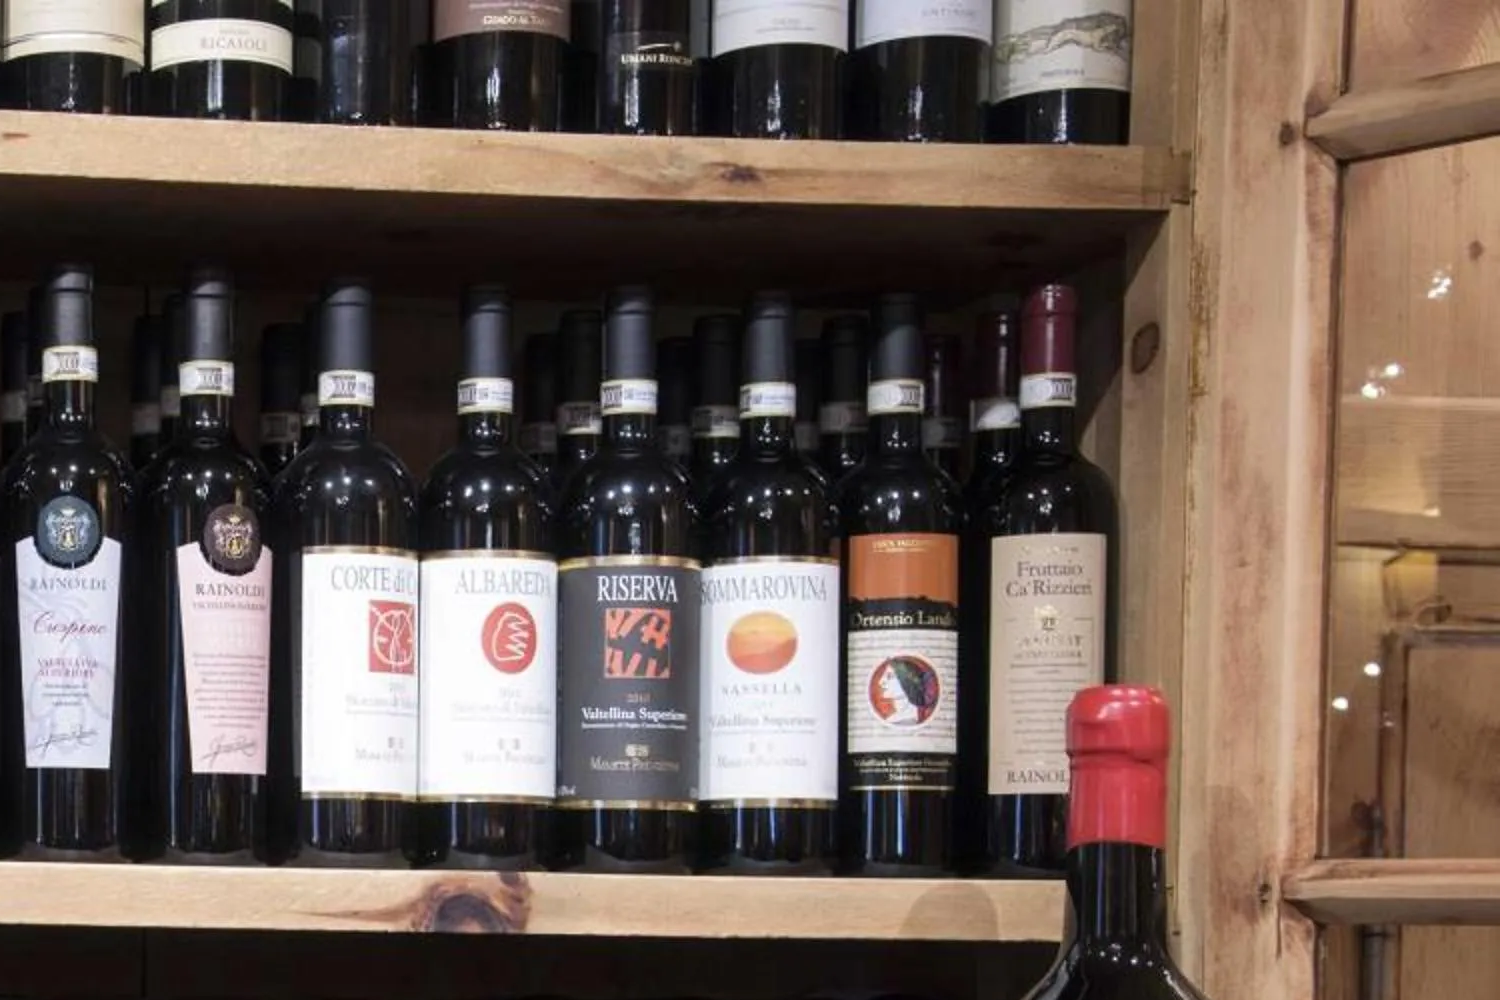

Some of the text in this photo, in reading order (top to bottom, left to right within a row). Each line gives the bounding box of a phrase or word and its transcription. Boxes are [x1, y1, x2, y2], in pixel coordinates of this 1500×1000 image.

[330, 564, 391, 593] CORTE
[597, 574, 680, 604] RISERVA
[194, 582, 266, 600] RAINOLDI
[1006, 767, 1070, 784] RAINOL
